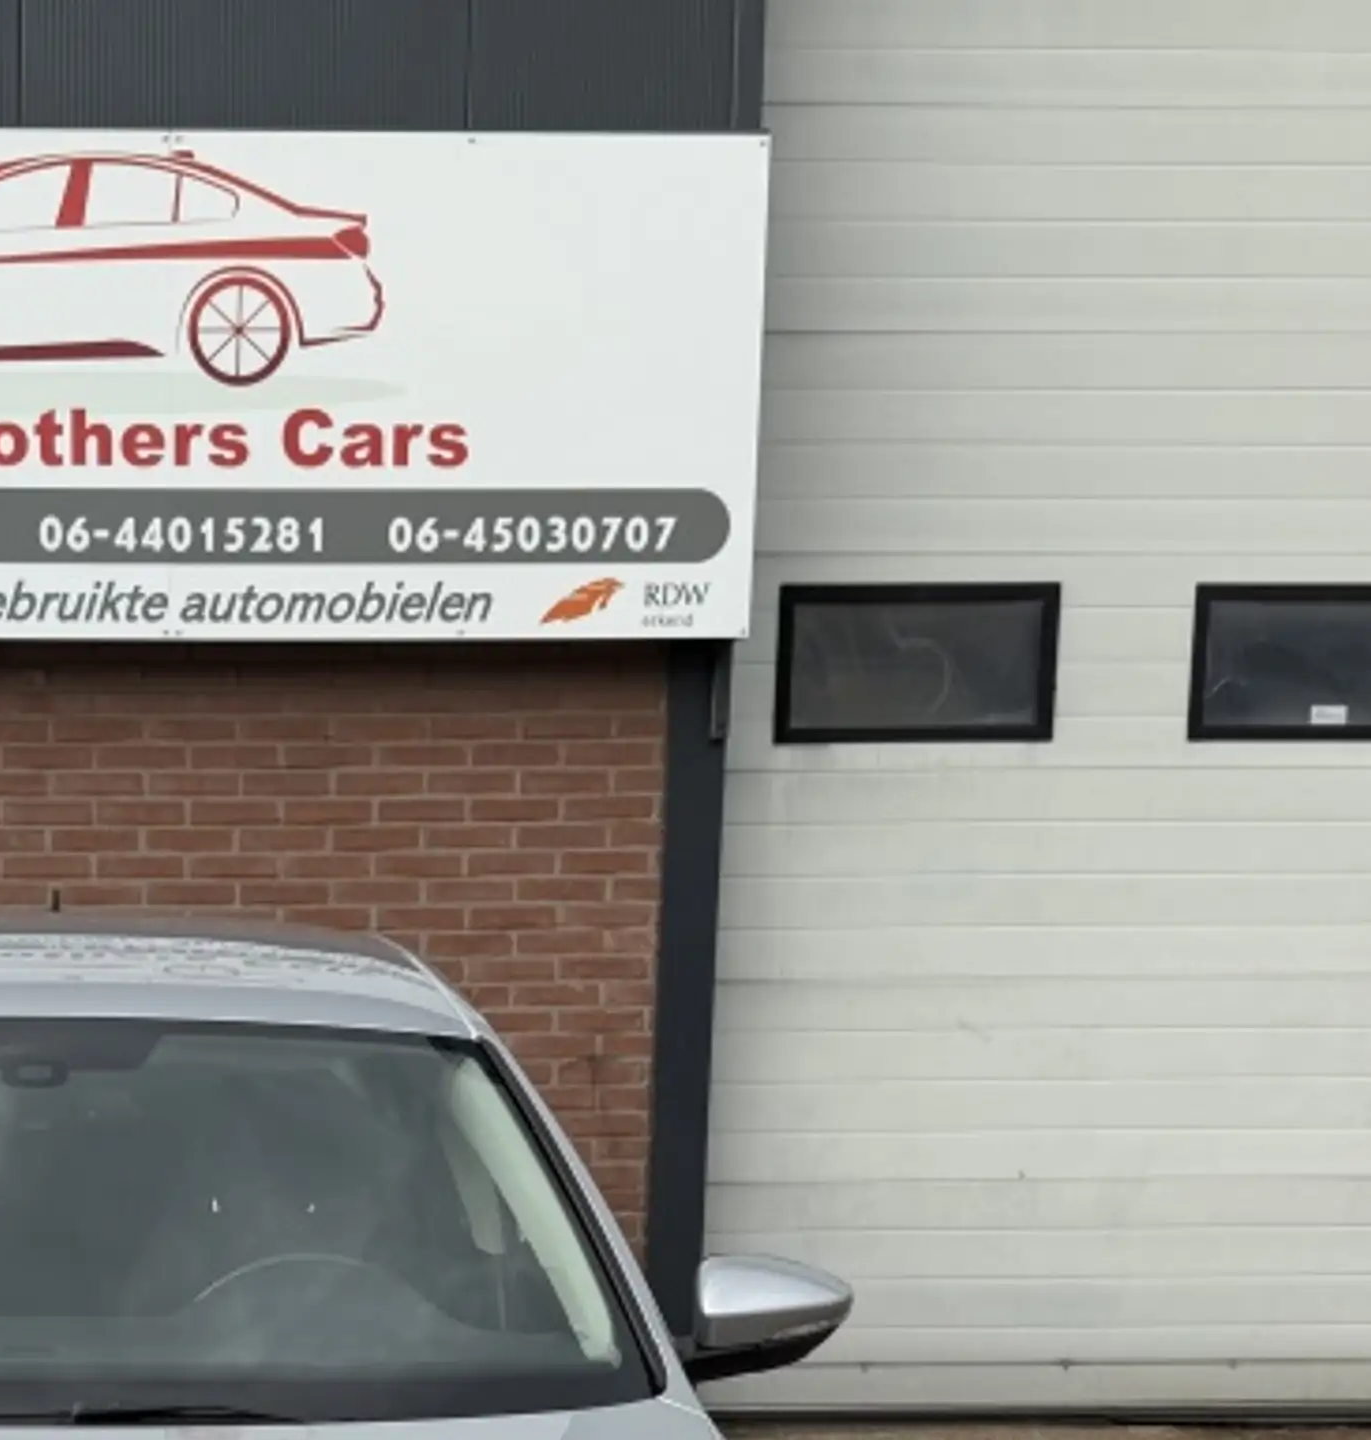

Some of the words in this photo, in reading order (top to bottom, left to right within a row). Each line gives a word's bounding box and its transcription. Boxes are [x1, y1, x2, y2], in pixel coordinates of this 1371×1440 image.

[281, 409, 468, 469] Cars
[38, 515, 324, 553] 06-44015281
[387, 516, 678, 553] 06-45030707
[180, 580, 493, 624] automobielen
[643, 582, 710, 607] RDW
